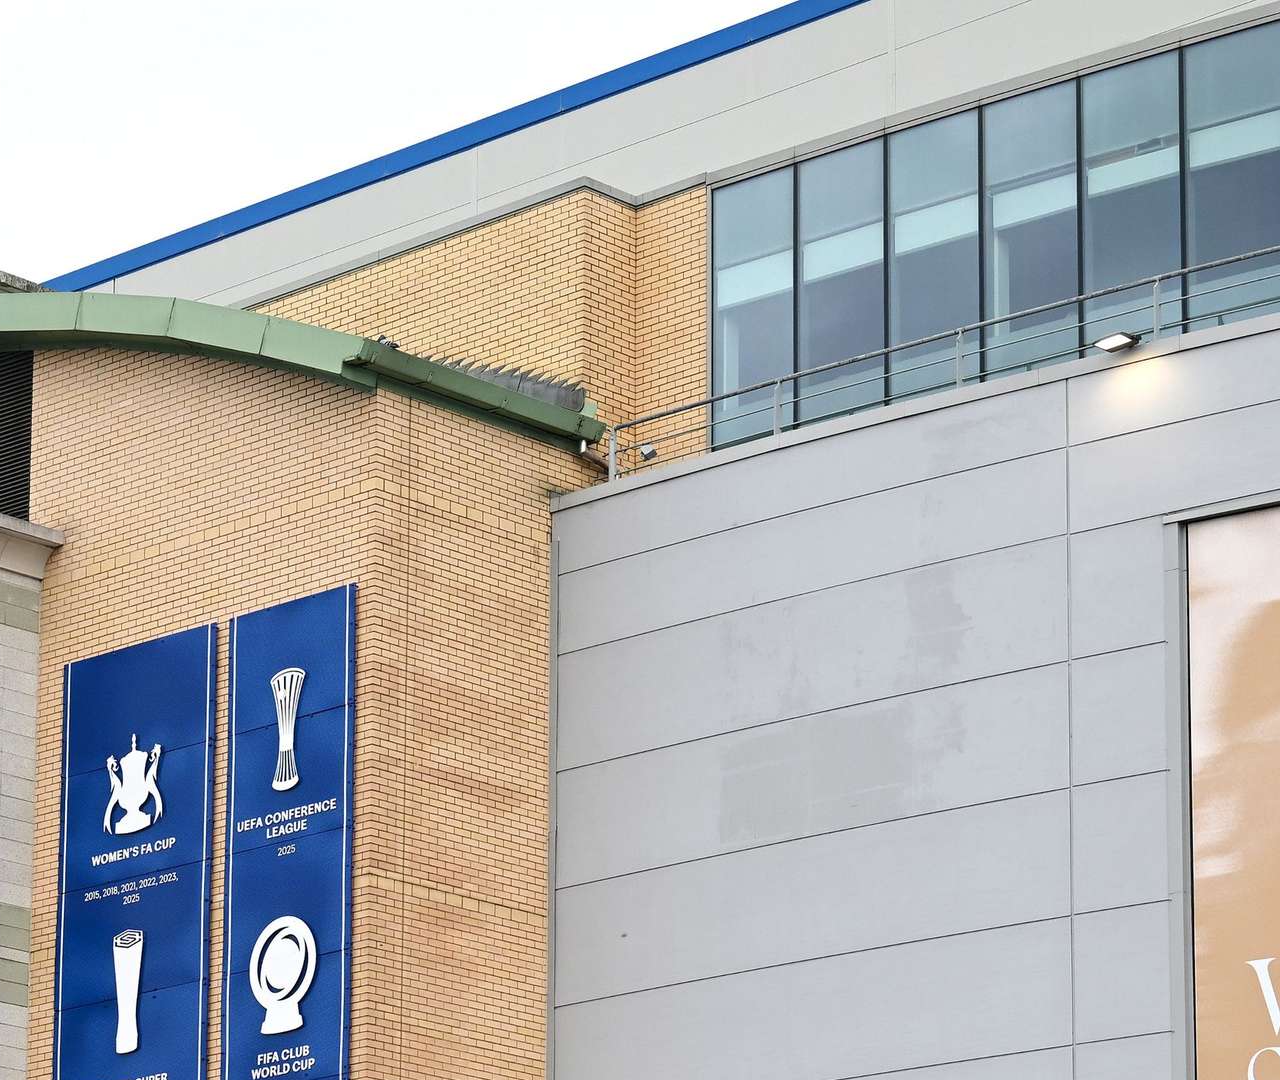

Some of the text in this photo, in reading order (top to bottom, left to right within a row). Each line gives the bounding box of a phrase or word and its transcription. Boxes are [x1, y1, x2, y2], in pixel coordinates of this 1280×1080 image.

[237, 799, 337, 832] UEFA CONFERENCE
[266, 819, 307, 839] LEAGUE
[92, 837, 176, 867] WOMEN'S FA CUP
[278, 844, 296, 856] 2025
[123, 894, 139, 904] 2025
[257, 1045, 310, 1065] FIFA CLUB
[251, 1058, 315, 1080] WORLD CUP
